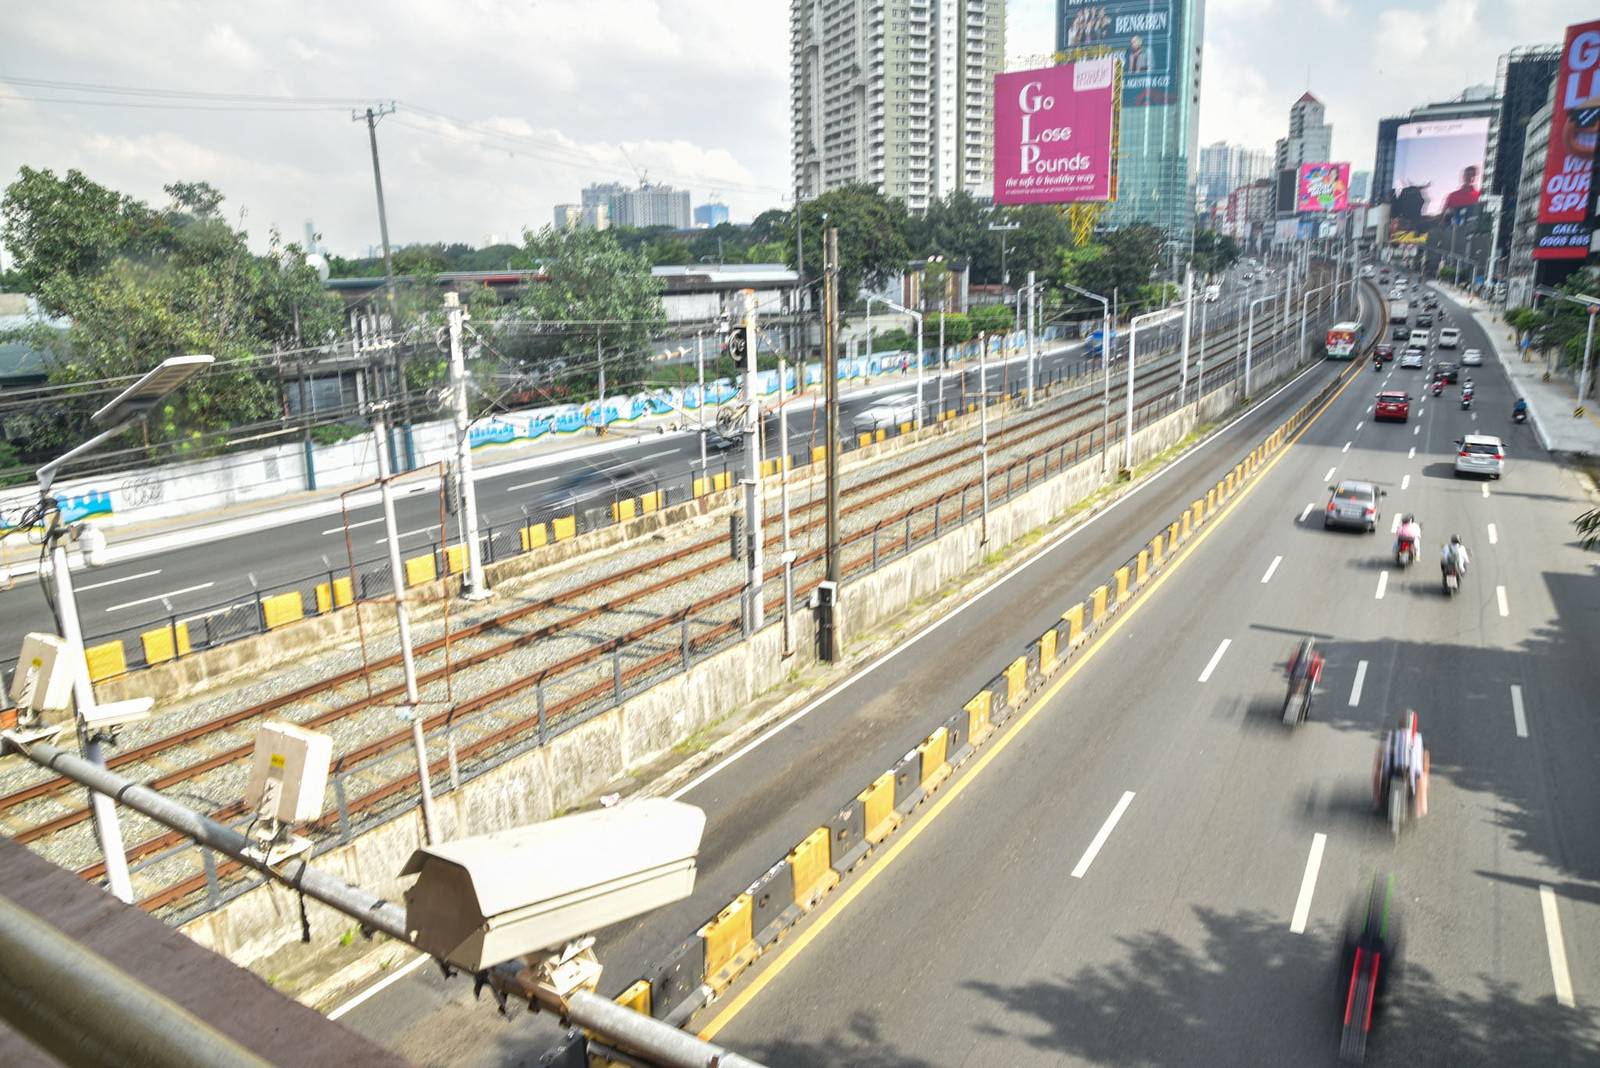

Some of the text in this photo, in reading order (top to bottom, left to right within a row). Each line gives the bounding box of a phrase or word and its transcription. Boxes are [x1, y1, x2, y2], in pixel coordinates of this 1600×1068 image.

[1115, 12, 1168, 33] BEN&BEN
[1567, 31, 1600, 71] G
[1019, 81, 1055, 113] Go
[1021, 114, 1072, 145] Lose
[1020, 144, 1090, 174] Pounds
[1005, 177, 1018, 187] the
[1019, 176, 1034, 188] safe
[1043, 173, 1075, 186] healthy
[1076, 173, 1096, 184] way
